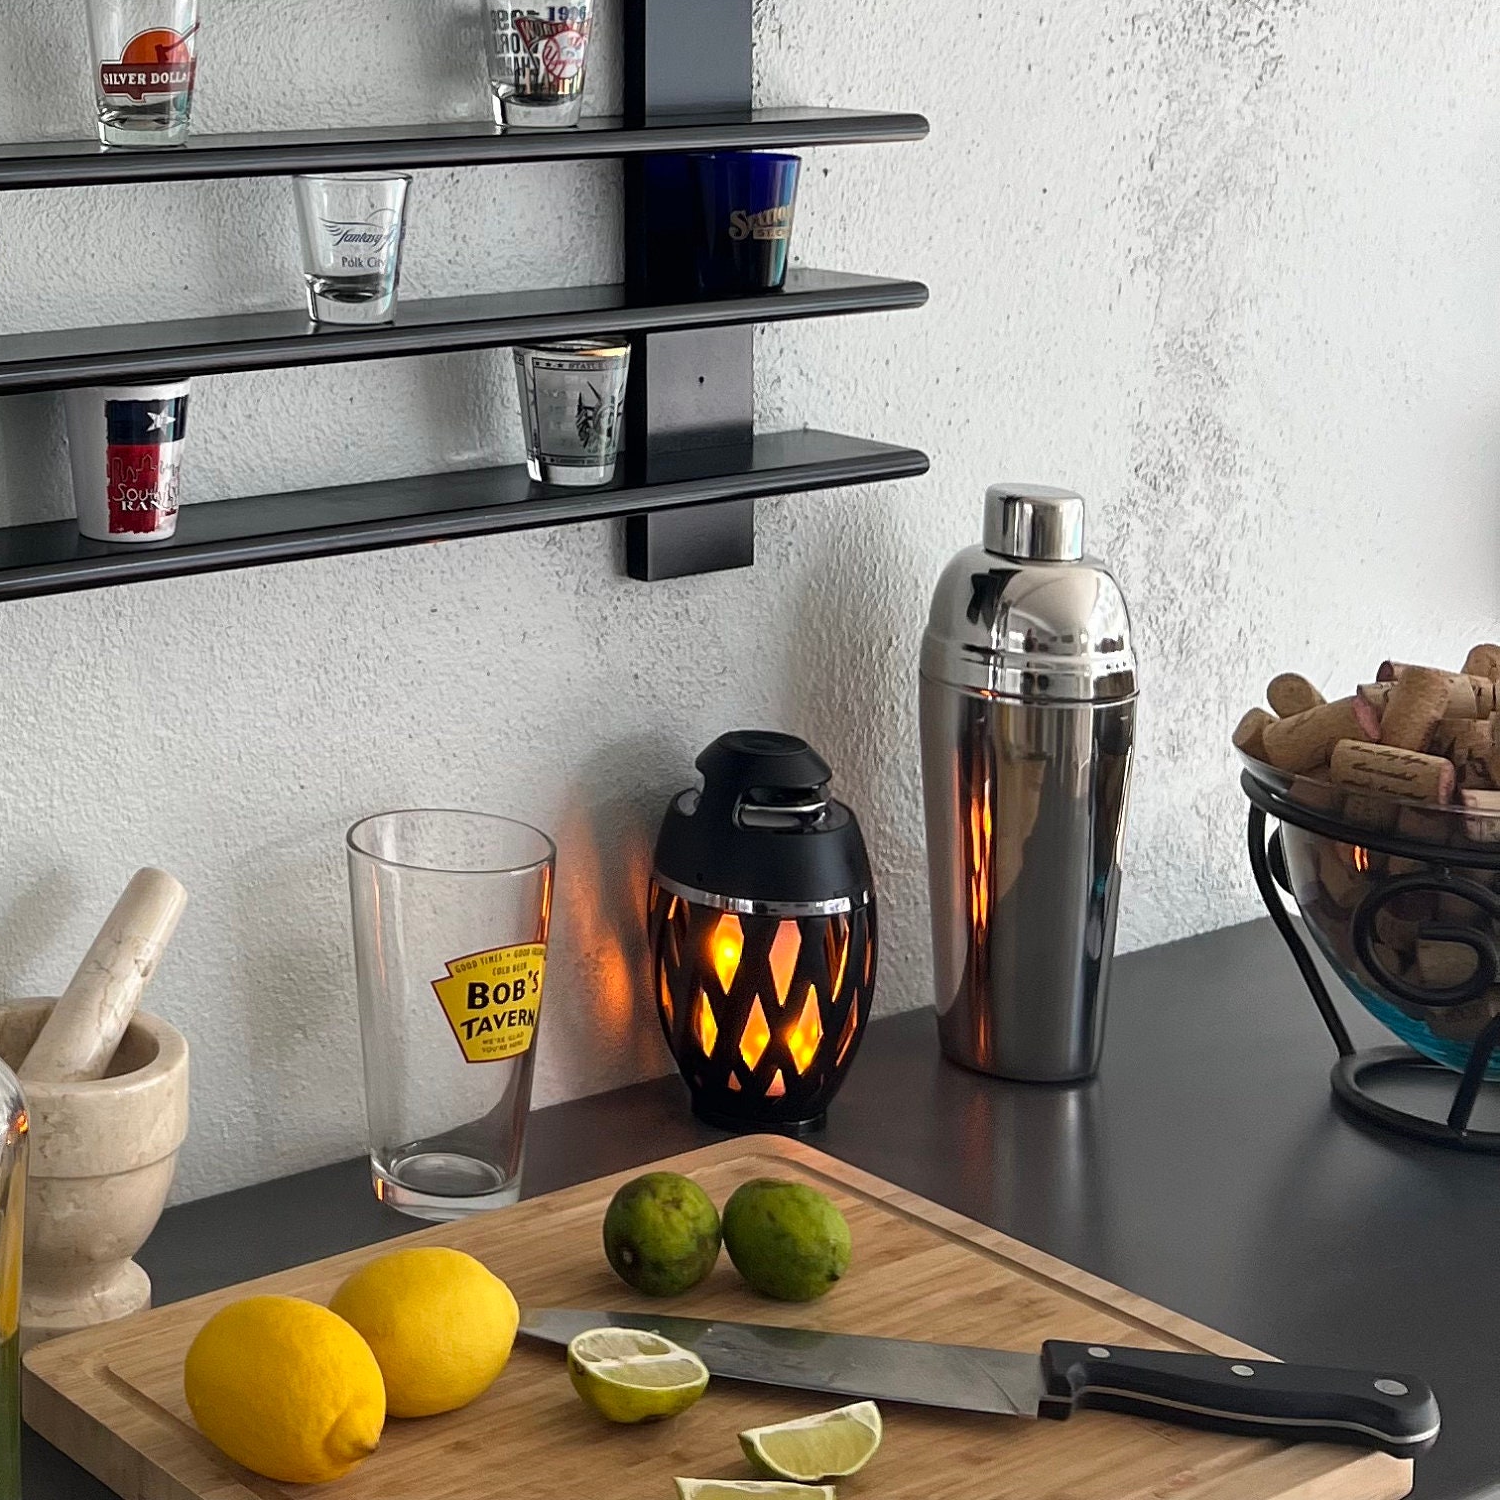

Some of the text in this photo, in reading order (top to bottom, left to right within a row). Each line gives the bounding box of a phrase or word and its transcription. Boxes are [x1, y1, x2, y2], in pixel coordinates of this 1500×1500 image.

[103, 72, 190, 85] SILVER DOLLA
[341, 256, 364, 268] Polk
[455, 959, 478, 974] GOOD
[480, 952, 503, 966] TIMES
[467, 969, 540, 1010] BOB'S
[460, 1008, 536, 1041] TAVERN
